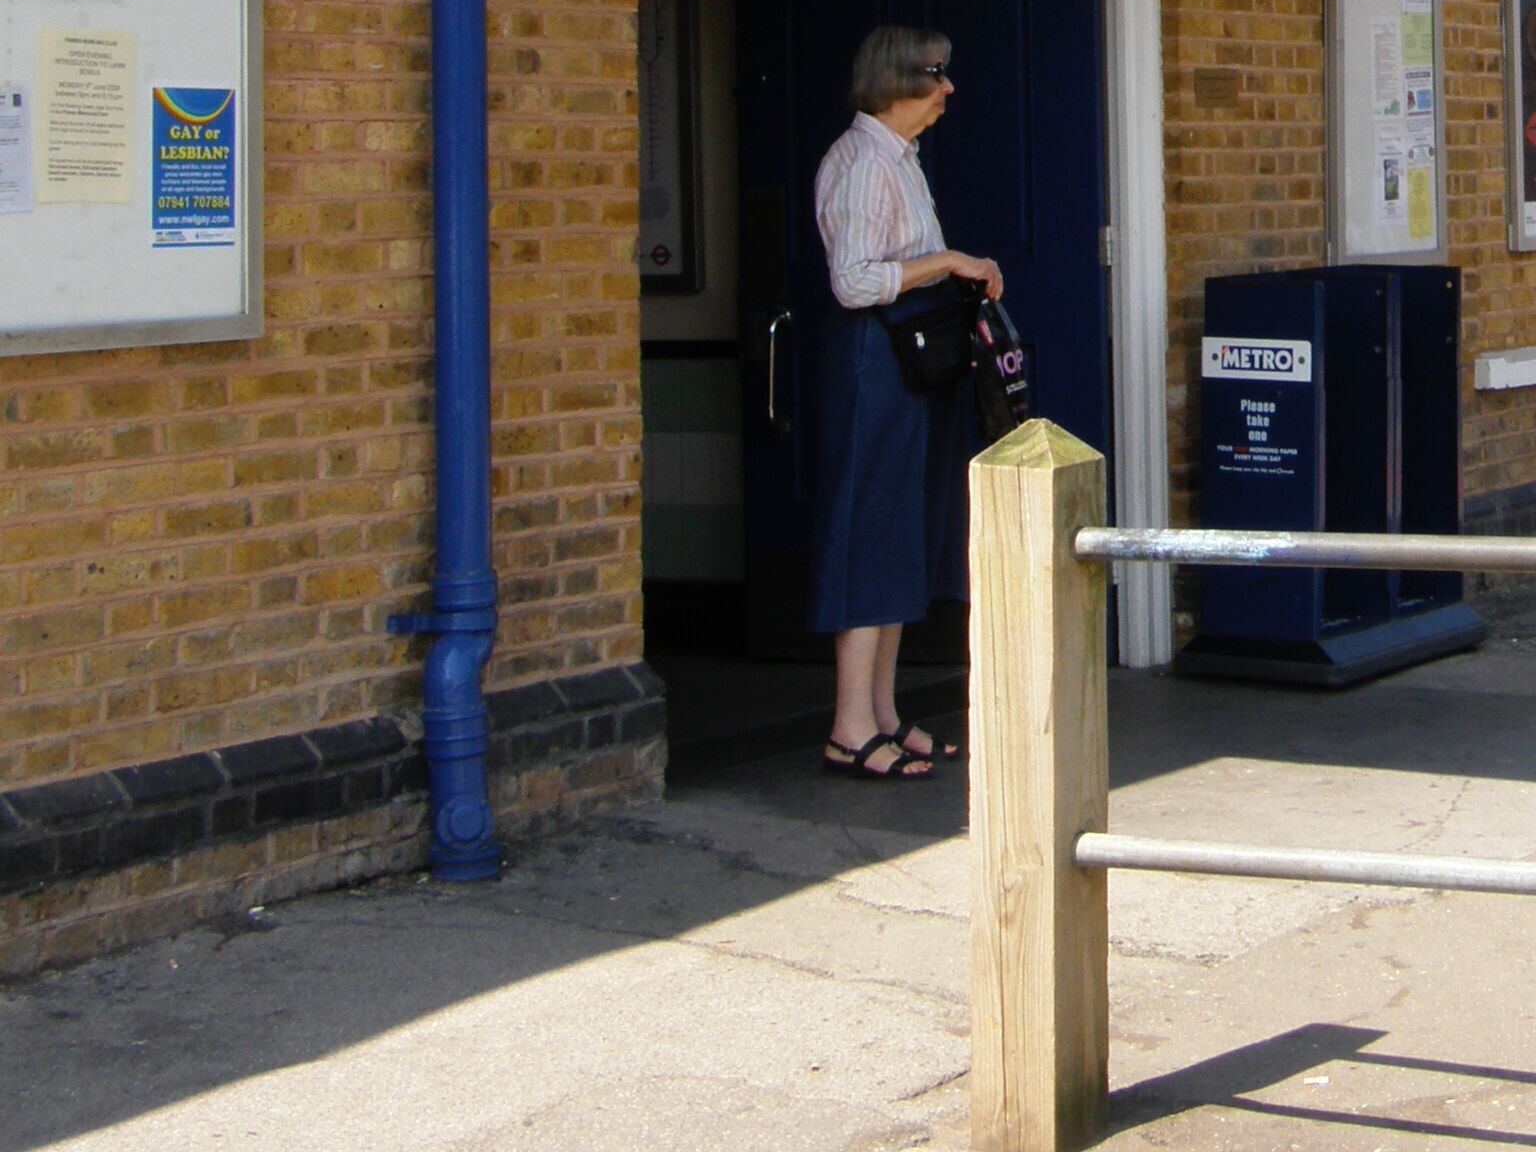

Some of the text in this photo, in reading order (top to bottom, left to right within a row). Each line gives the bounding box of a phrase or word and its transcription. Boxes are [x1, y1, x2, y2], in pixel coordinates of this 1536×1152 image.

[169, 125, 221, 140] GAY or
[160, 145, 230, 160] LESBIAN?
[158, 195, 190, 209] 07941
[1222, 348, 1292, 370] METRO
[1240, 399, 1276, 413] Please
[1246, 414, 1270, 427] take
[1248, 430, 1268, 442] one
